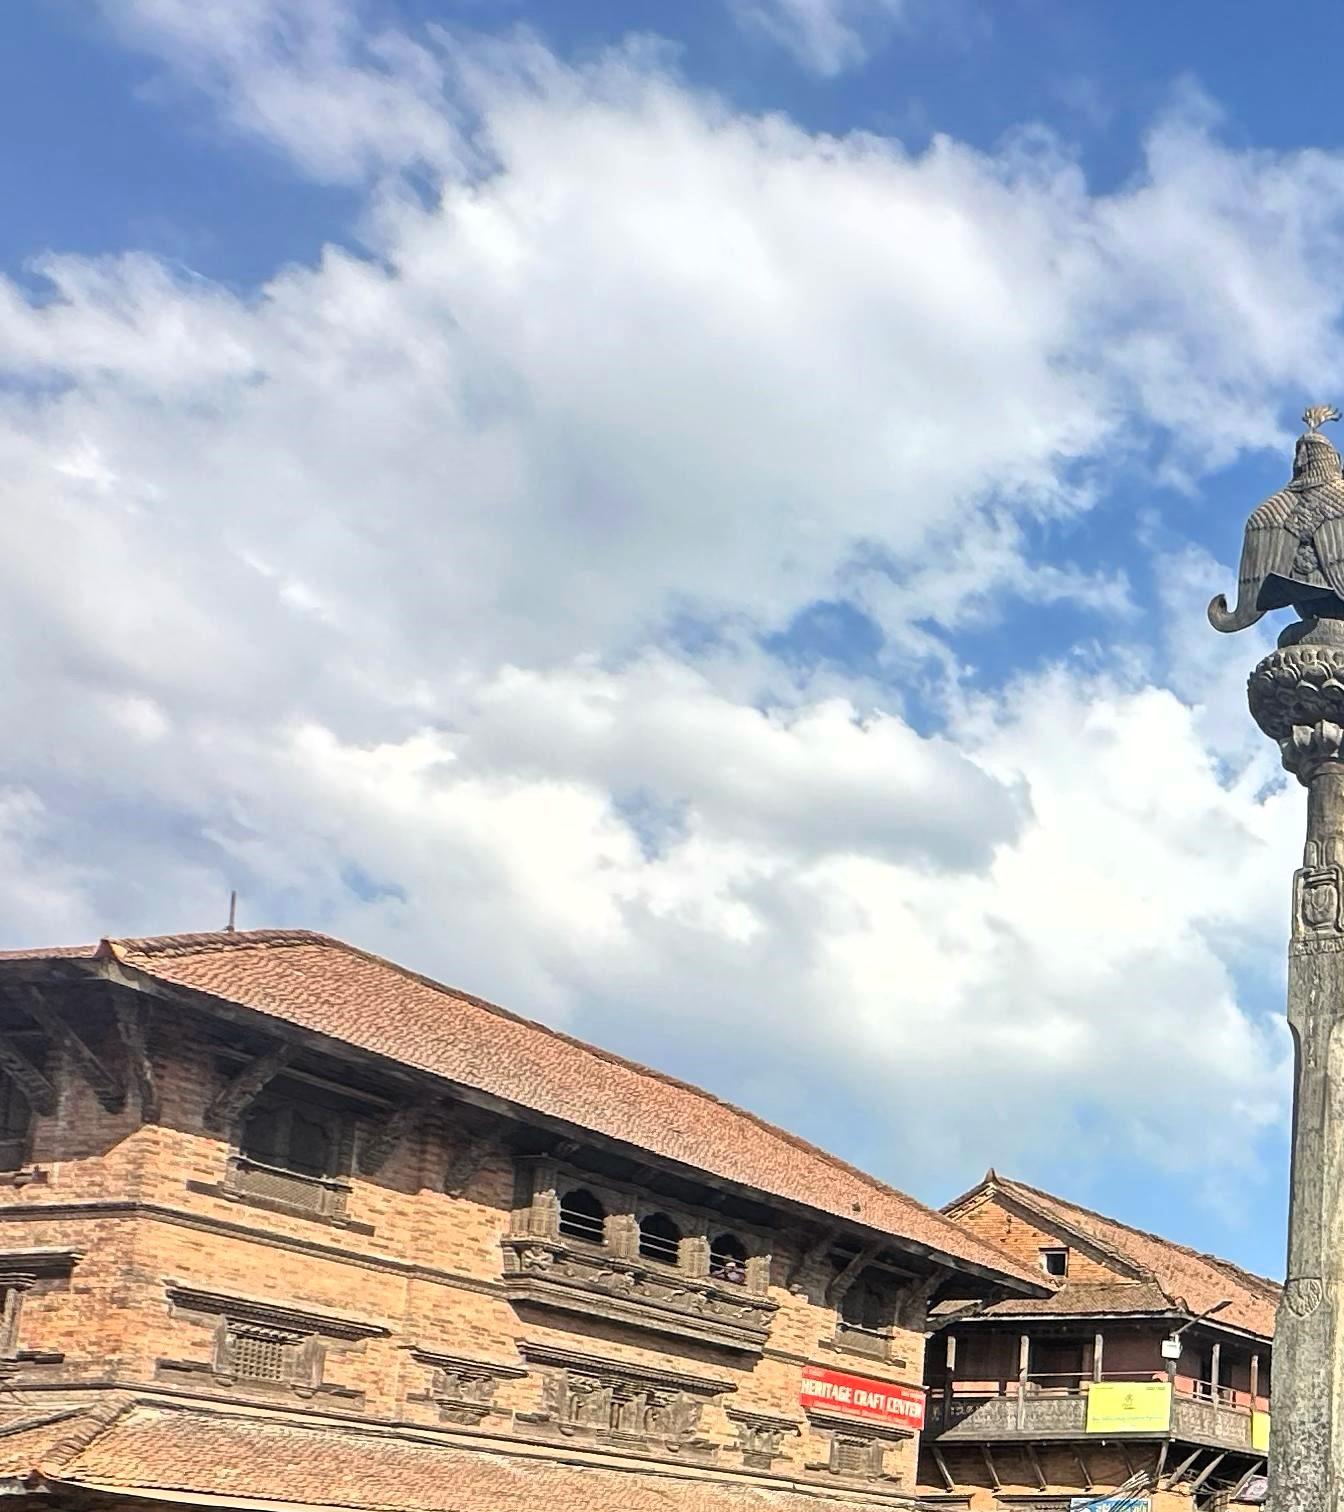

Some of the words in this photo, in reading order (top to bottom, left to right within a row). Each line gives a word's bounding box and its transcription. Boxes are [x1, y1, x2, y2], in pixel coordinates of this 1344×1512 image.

[801, 1378, 853, 1403] HERITAGE
[853, 1389, 885, 1410] CRAFT
[886, 1397, 922, 1417] CENTER
